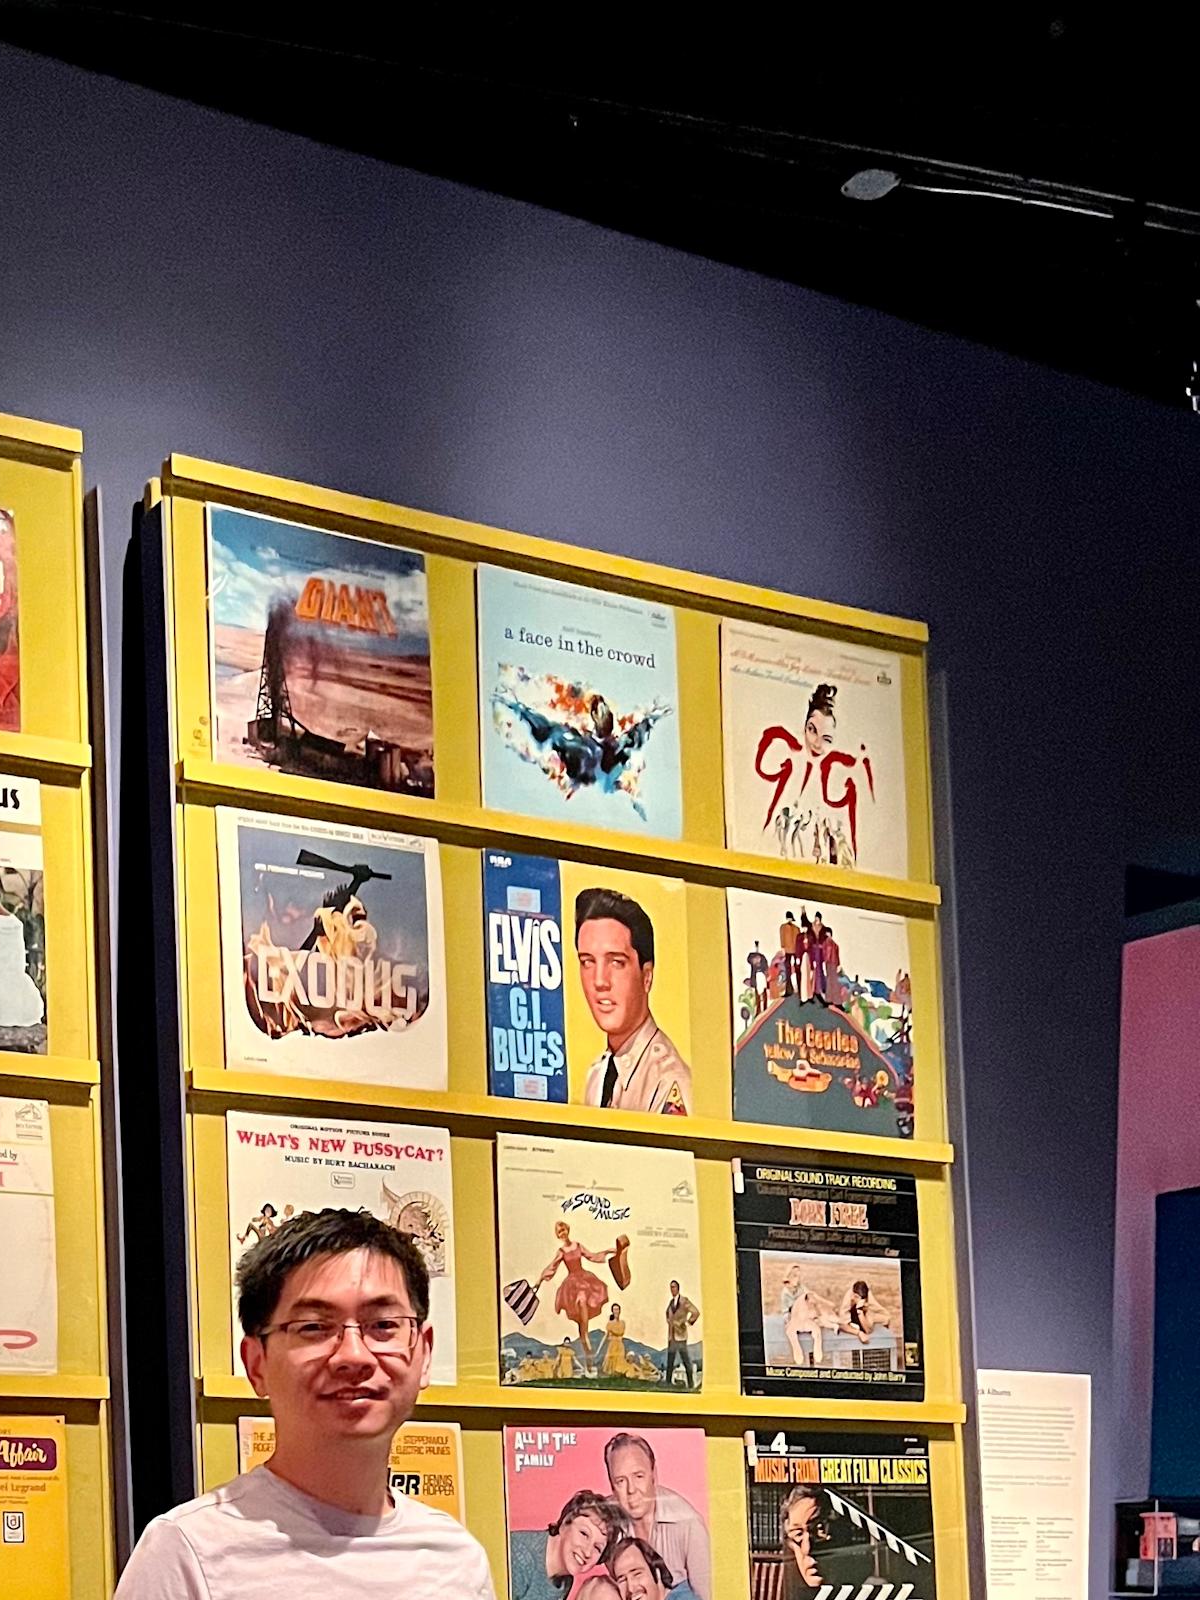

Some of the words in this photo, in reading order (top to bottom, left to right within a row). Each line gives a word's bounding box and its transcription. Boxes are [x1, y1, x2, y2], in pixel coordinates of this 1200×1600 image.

[295, 576, 398, 640] GIANT
[504, 627, 513, 640] a
[519, 629, 553, 647] face
[558, 635, 574, 651] in
[578, 640, 603, 657] the
[608, 647, 656, 668] crowd
[257, 947, 417, 1021] EXODUS
[509, 987, 546, 1030] G.I.
[775, 1019, 803, 1045] The
[492, 1028, 564, 1076] BLUES
[237, 1130, 299, 1150] WHAT'S
[309, 1138, 346, 1152] NEW
[353, 1141, 444, 1162] PUSSYCAT?
[285, 1155, 310, 1164] MUSIC
[313, 1157, 323, 1165] BY
[756, 1167, 794, 1182] ORIGINAL
[794, 1171, 823, 1185] SOUND
[825, 1174, 850, 1187] TRACK
[851, 1175, 896, 1191] RECORDING
[572, 1193, 610, 1211] SOUND
[594, 1207, 630, 1220] MUSIC
[514, 1431, 535, 1450] ALL
[552, 1432, 577, 1451] THE
[770, 1432, 788, 1455] 4
[515, 1453, 554, 1472] FAMILY
[754, 1458, 788, 1483] MUSIC
[789, 1458, 820, 1483] FROM
[821, 1458, 852, 1484] GREAT
[853, 1459, 879, 1484] FILM
[880, 1459, 927, 1484] CLASSICS
[423, 1474, 453, 1487] DENNIS
